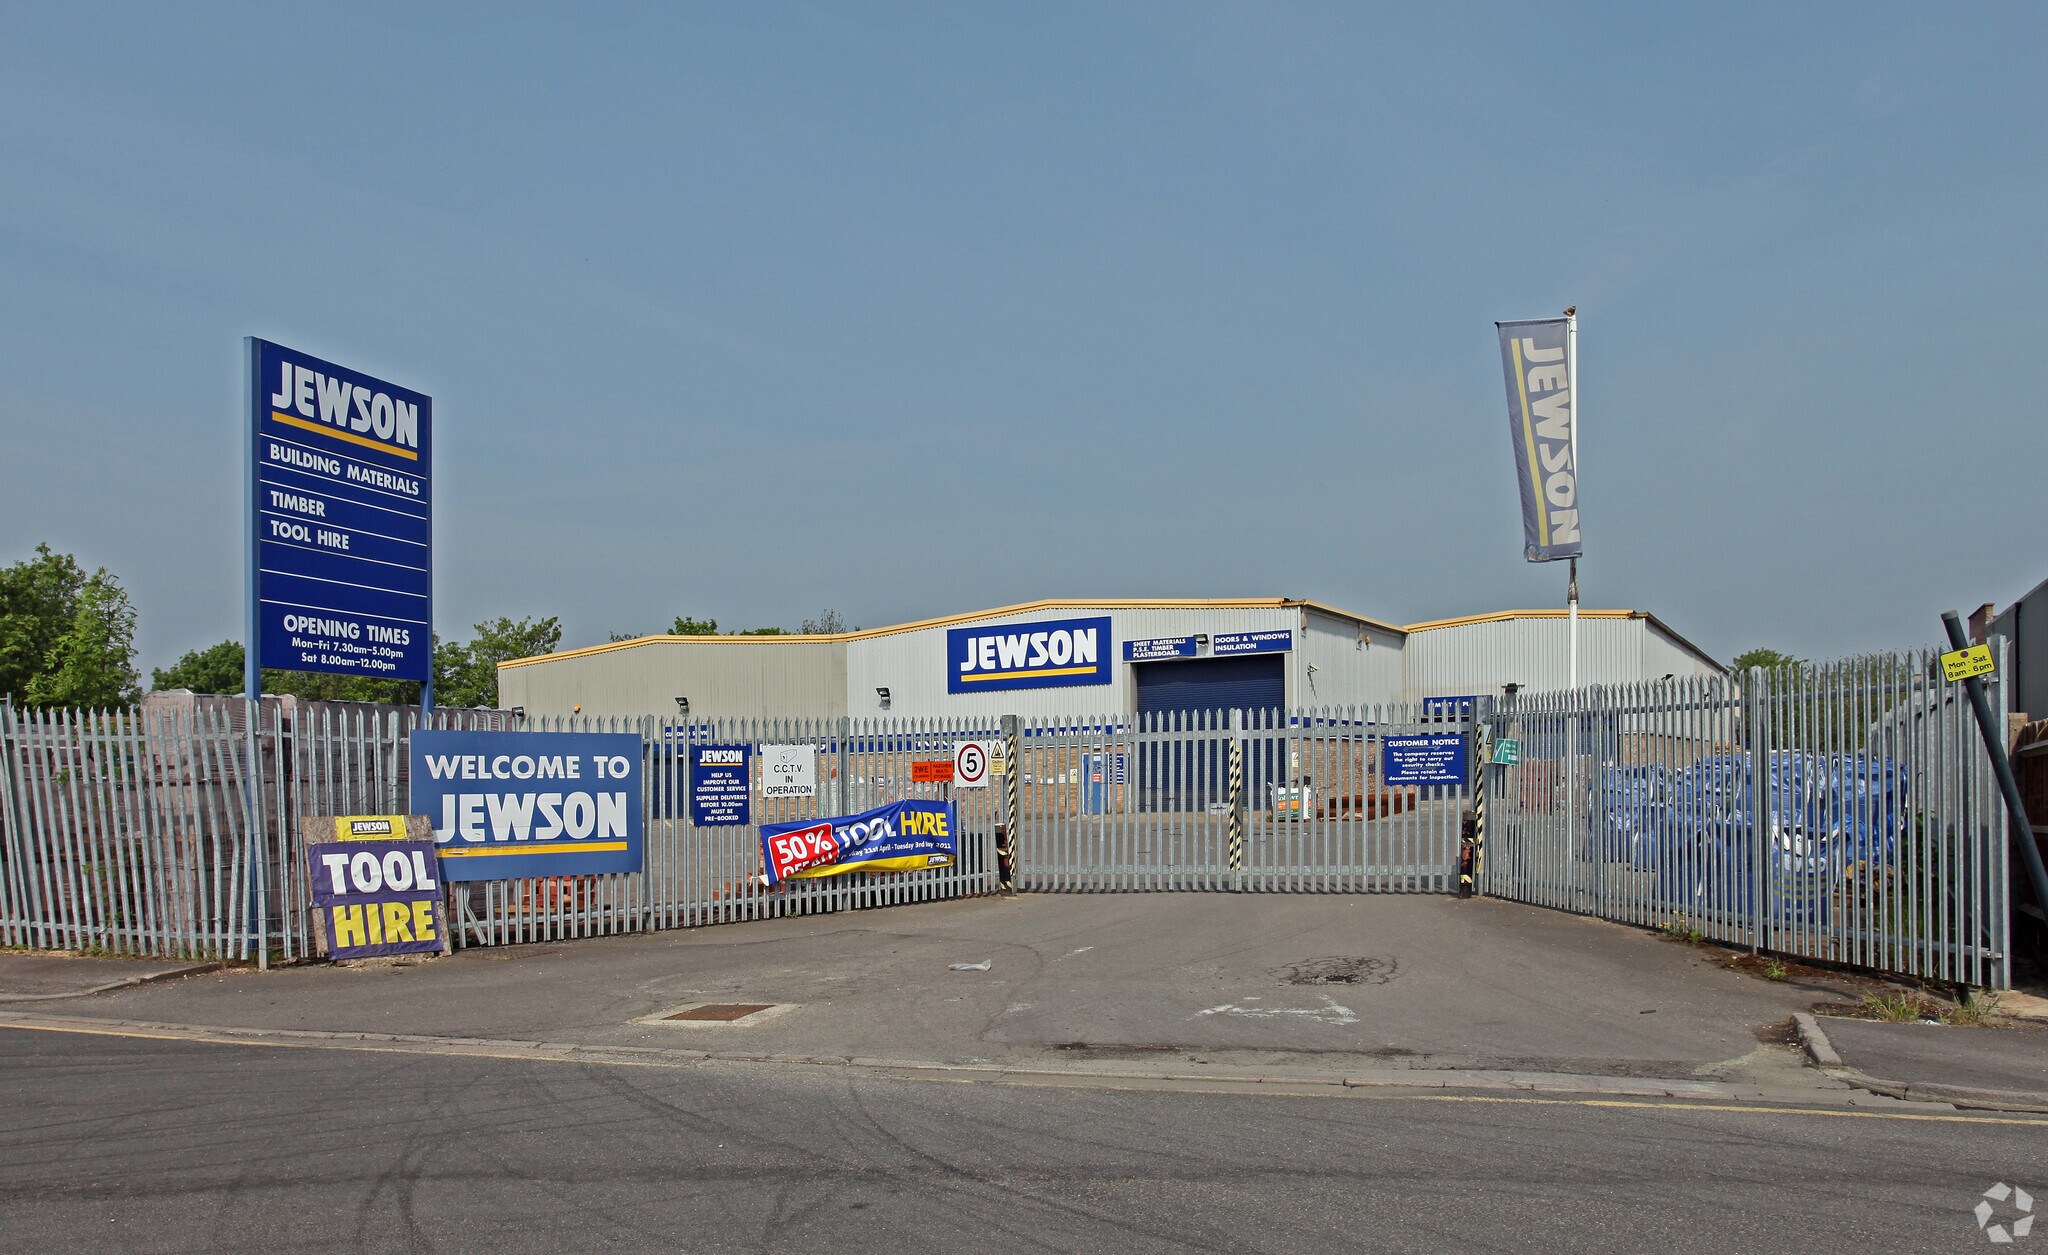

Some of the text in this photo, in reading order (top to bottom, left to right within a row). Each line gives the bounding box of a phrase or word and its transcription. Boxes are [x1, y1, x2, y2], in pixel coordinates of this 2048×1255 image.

[272, 361, 417, 448] JEWSON
[1522, 338, 1580, 545] JEWSON
[270, 444, 419, 496] BUILDING MATERIALS
[270, 490, 326, 517] TIMBER
[270, 520, 350, 550] TOOL HIRE
[284, 614, 410, 646] OPENING TIMES
[1252, 632, 1290, 641] WINDOWS
[302, 652, 318, 664] Sat
[960, 628, 1097, 672] JEWSON
[1133, 650, 1180, 658] PLASTERBOARD
[1215, 643, 1256, 652] INSULATION
[1948, 661, 1966, 669] Mon
[1972, 655, 1987, 664] Sat
[425, 754, 630, 780] WELCOME TO
[700, 750, 743, 763] JEWSON
[774, 765, 804, 773] C.C.T.V.
[966, 753, 978, 772] 5
[767, 786, 812, 794] OPERATION
[352, 820, 389, 832] JEWSON
[433, 792, 628, 844] JEWSON
[836, 811, 949, 848] TOOL HIRE
[775, 828, 832, 864] 50%
[879, 842, 891, 853] April
[894, 841, 914, 852] Tuesday
[322, 850, 435, 895] TOOL
[332, 900, 436, 948] HIRE
